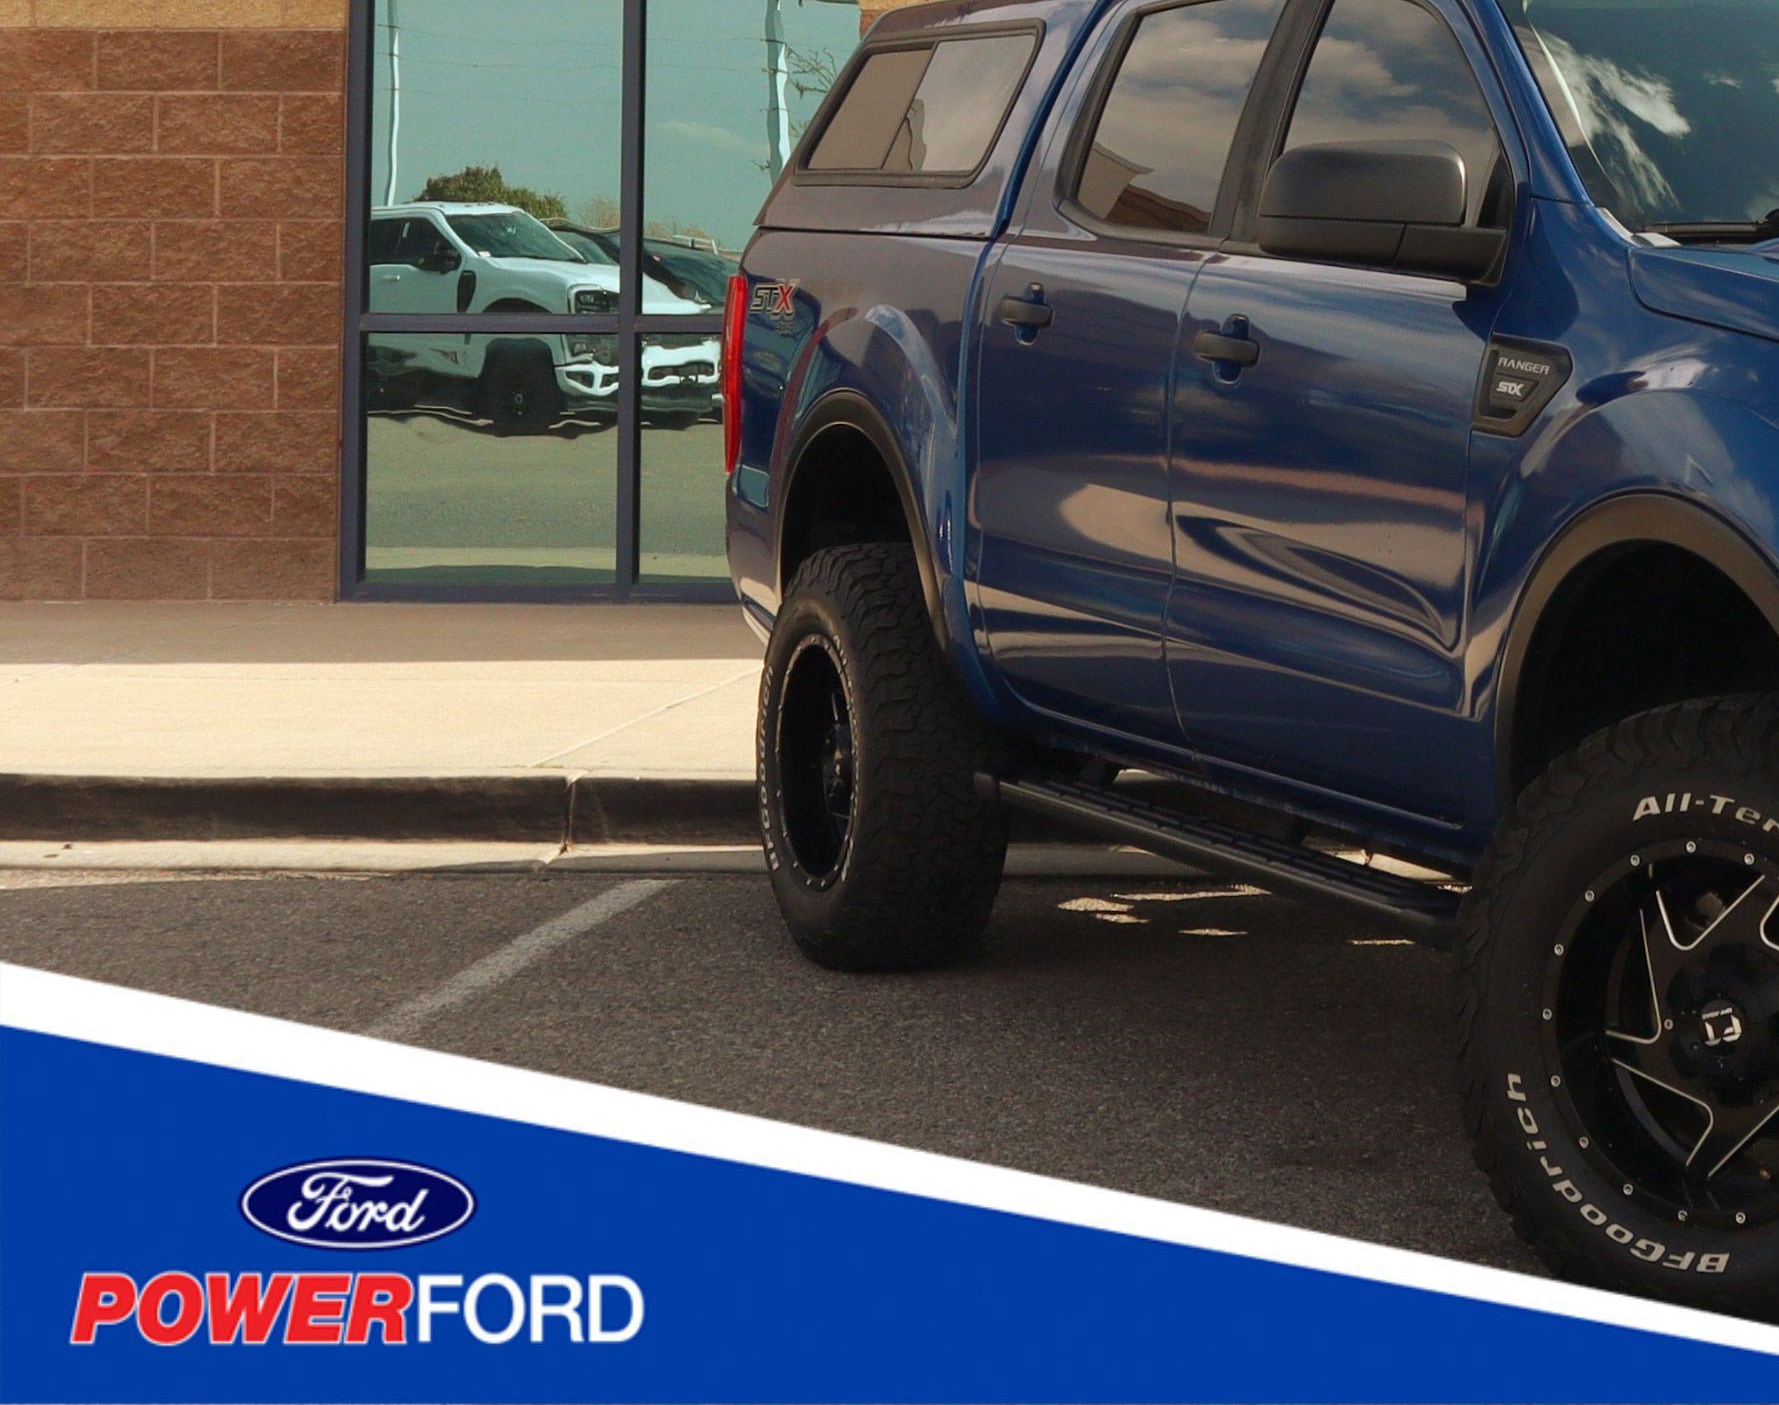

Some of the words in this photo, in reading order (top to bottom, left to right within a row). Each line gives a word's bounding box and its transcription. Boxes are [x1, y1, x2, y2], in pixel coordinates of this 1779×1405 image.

[750, 279, 799, 318] STX
[1498, 357, 1550, 375] RANGER
[1496, 382, 1523, 396] STX
[1505, 1071, 1731, 1275] BFGoodrich
